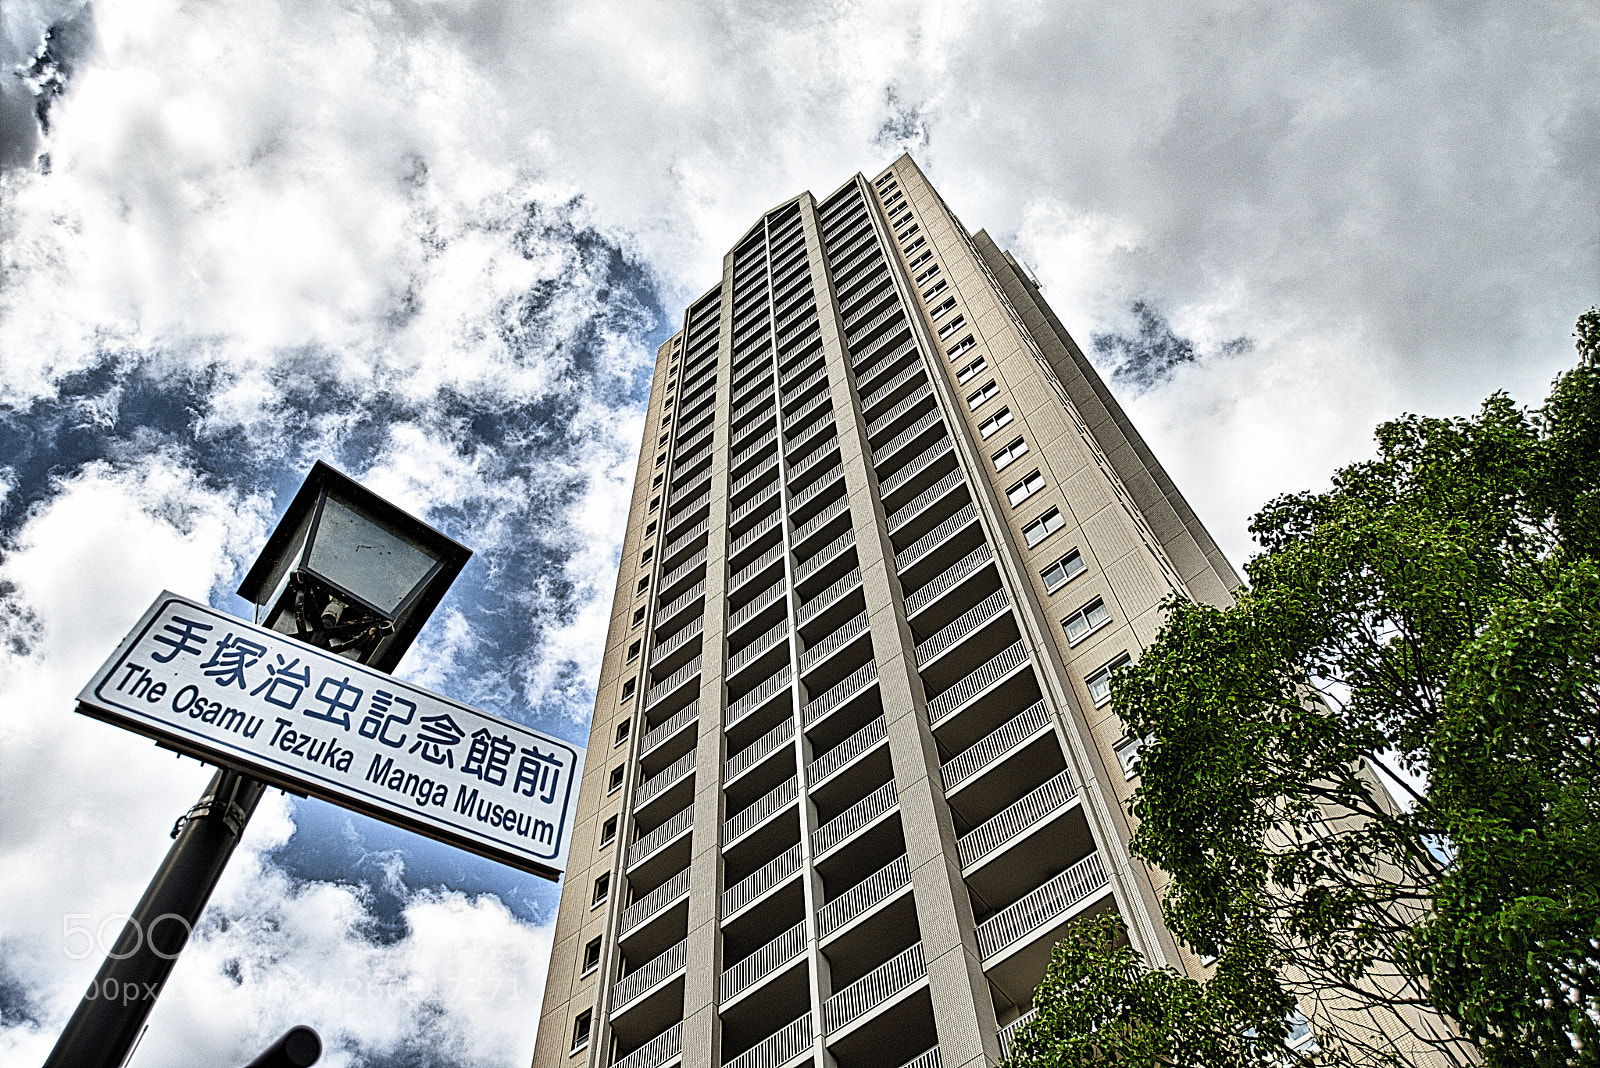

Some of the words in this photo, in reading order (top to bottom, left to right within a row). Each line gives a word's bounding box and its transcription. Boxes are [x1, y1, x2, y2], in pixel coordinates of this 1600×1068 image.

[117, 662, 168, 704] The
[172, 685, 265, 740] Osamu
[268, 717, 354, 774] Tezuka
[365, 754, 449, 808] Manga
[453, 785, 554, 846] Museum
[151, 616, 564, 804] 手塚治虫記念館前
